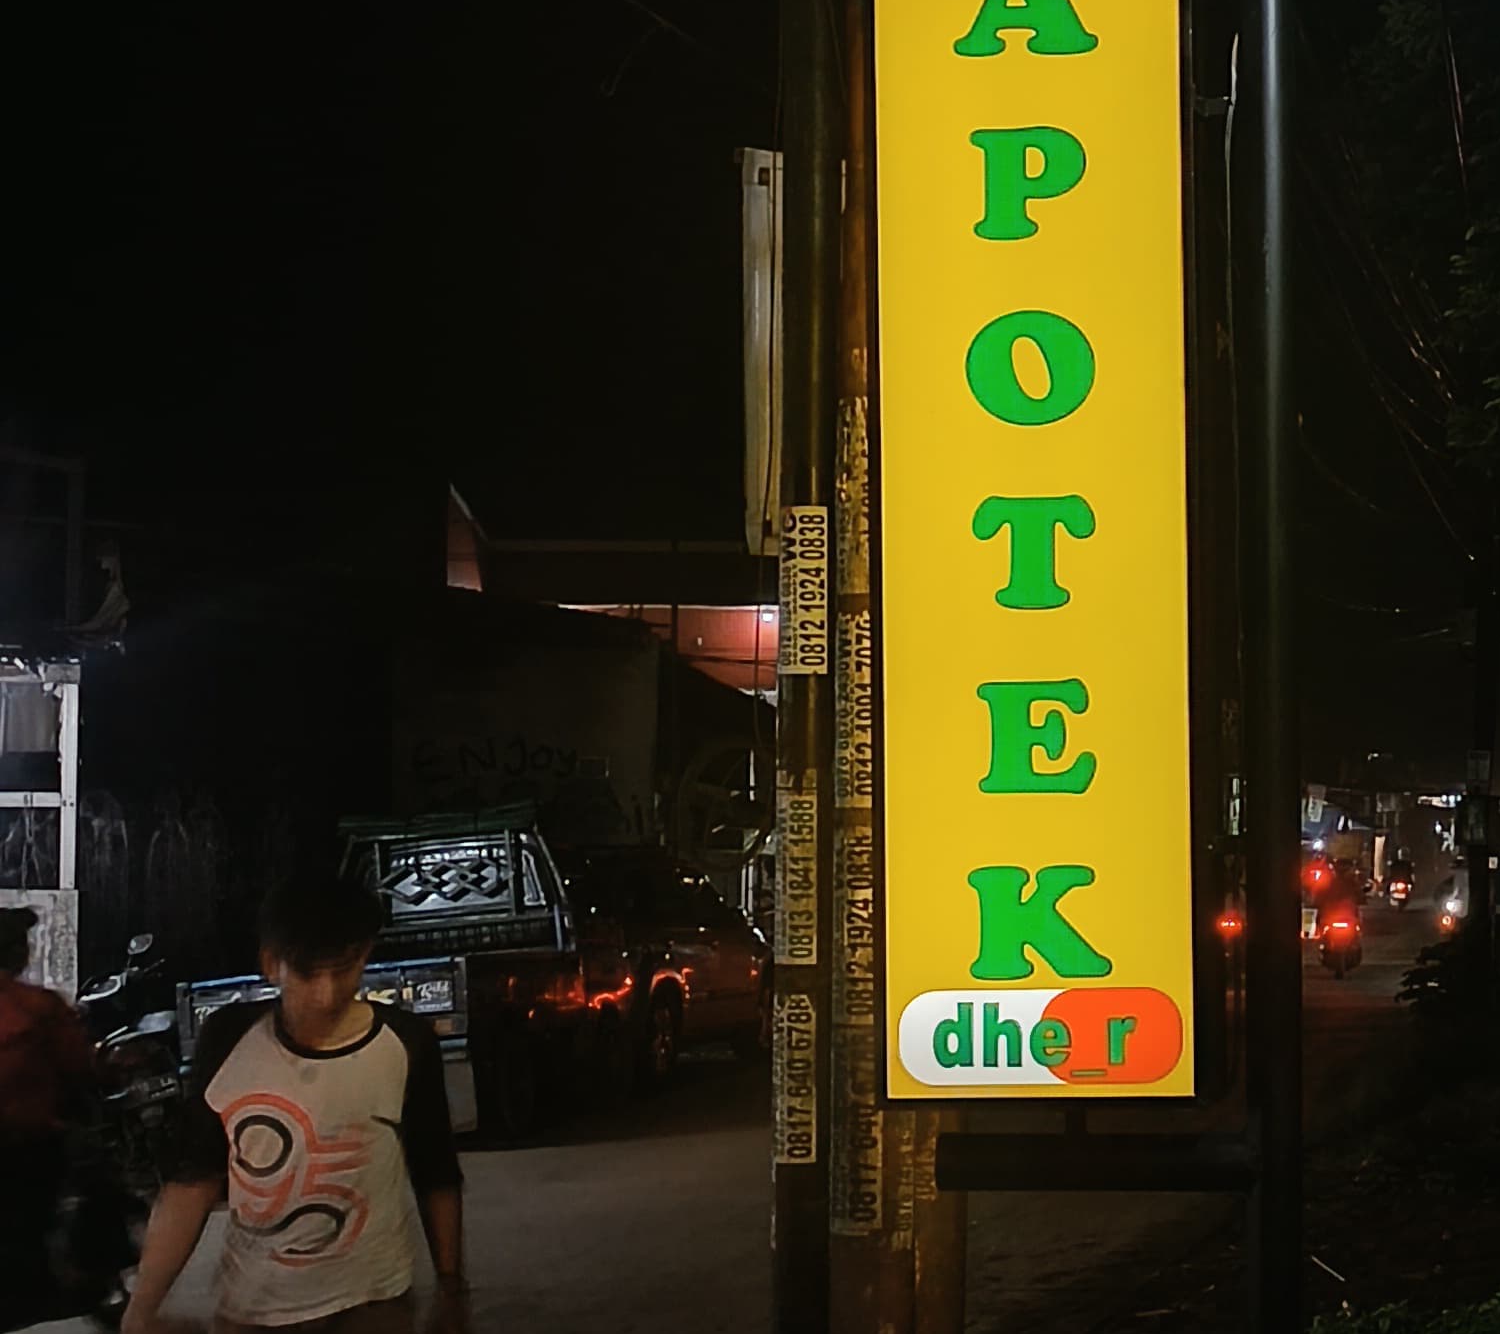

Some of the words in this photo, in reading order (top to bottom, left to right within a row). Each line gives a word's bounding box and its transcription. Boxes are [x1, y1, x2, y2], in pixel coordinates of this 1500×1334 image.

[799, 514, 825, 560] 0838
[799, 567, 825, 612] 1924
[799, 620, 825, 666] 0812
[788, 799, 814, 846] 1588
[788, 909, 814, 958] 0813
[786, 1105, 812, 1158] 0817
